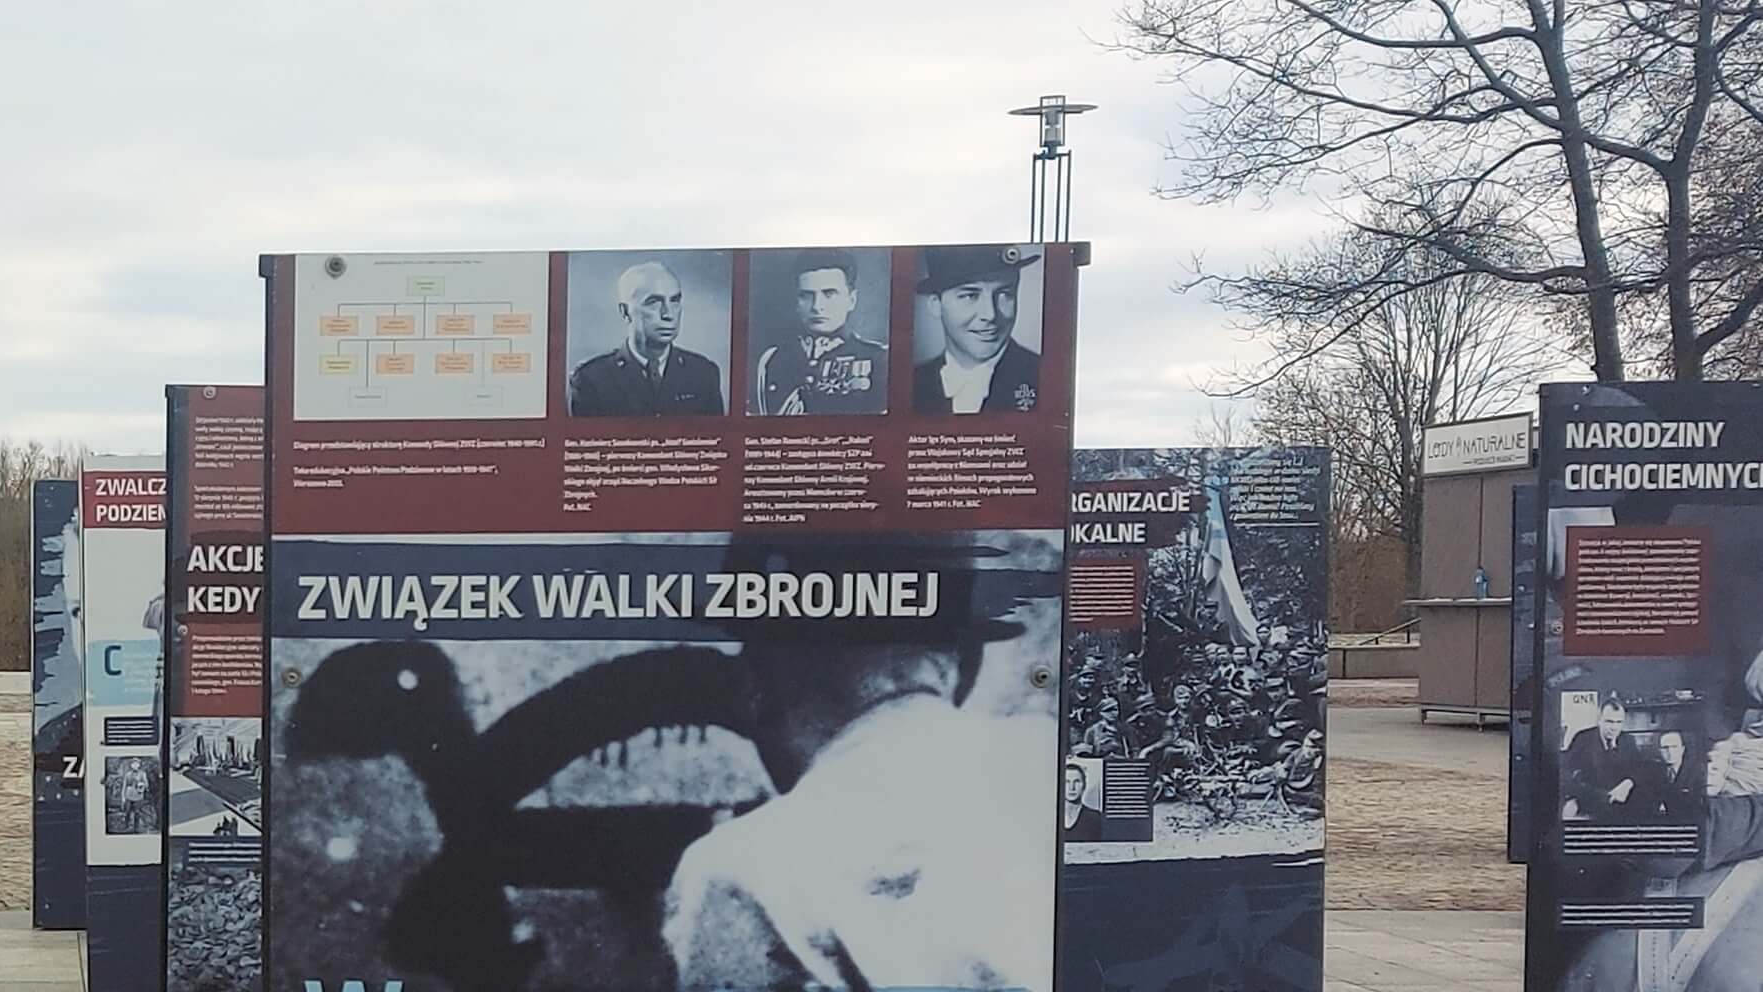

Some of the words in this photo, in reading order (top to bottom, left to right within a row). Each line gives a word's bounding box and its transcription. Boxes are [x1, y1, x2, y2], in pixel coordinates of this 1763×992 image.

[1565, 421, 1725, 449] NARODZINY
[95, 478, 167, 496] ZWALCZ
[1564, 462, 1763, 490] CICHOCIEMNYC
[1070, 522, 1146, 543] KALNE
[187, 545, 264, 572] AKCJE
[187, 586, 262, 613] KEDY
[297, 574, 523, 631] ZWIĄZEK
[532, 573, 694, 620] WALKI
[704, 571, 942, 619] ZBROJNEJ
